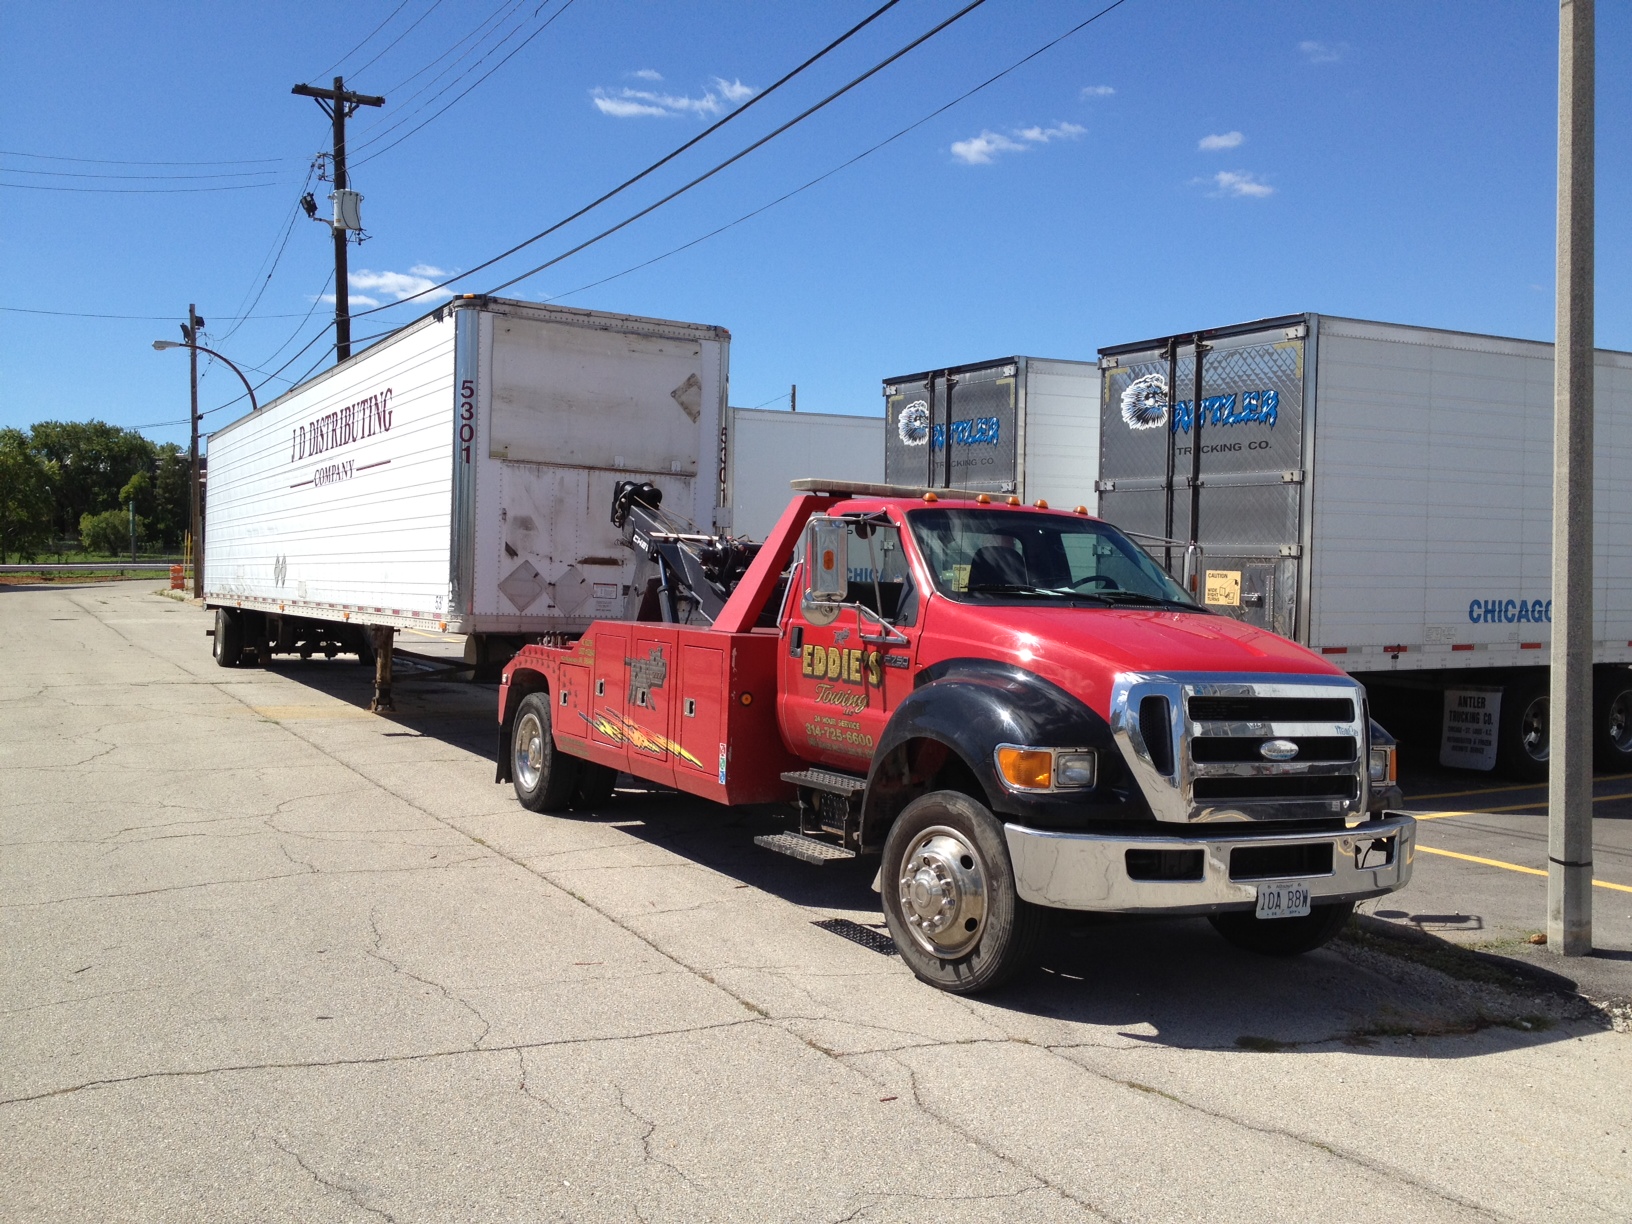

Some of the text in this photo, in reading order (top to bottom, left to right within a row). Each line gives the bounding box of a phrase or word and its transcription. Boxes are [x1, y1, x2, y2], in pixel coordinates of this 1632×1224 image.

[291, 388, 393, 463] J D DISTRIBUTING
[460, 380, 474, 464] 5301
[1177, 440, 1272, 455] TRCKING CO.
[314, 459, 355, 487] COMPANY
[935, 459, 977, 469] TRCKING
[802, 644, 882, 688] EDDIE'S
[815, 683, 869, 713] Towing
[1458, 695, 1486, 709] ANTLER
[822, 716, 836, 726] HOUR
[838, 720, 860, 730] SERVICE
[1449, 710, 1493, 725] TRUCKING CO.
[805, 723, 873, 747] 314-725-6600
